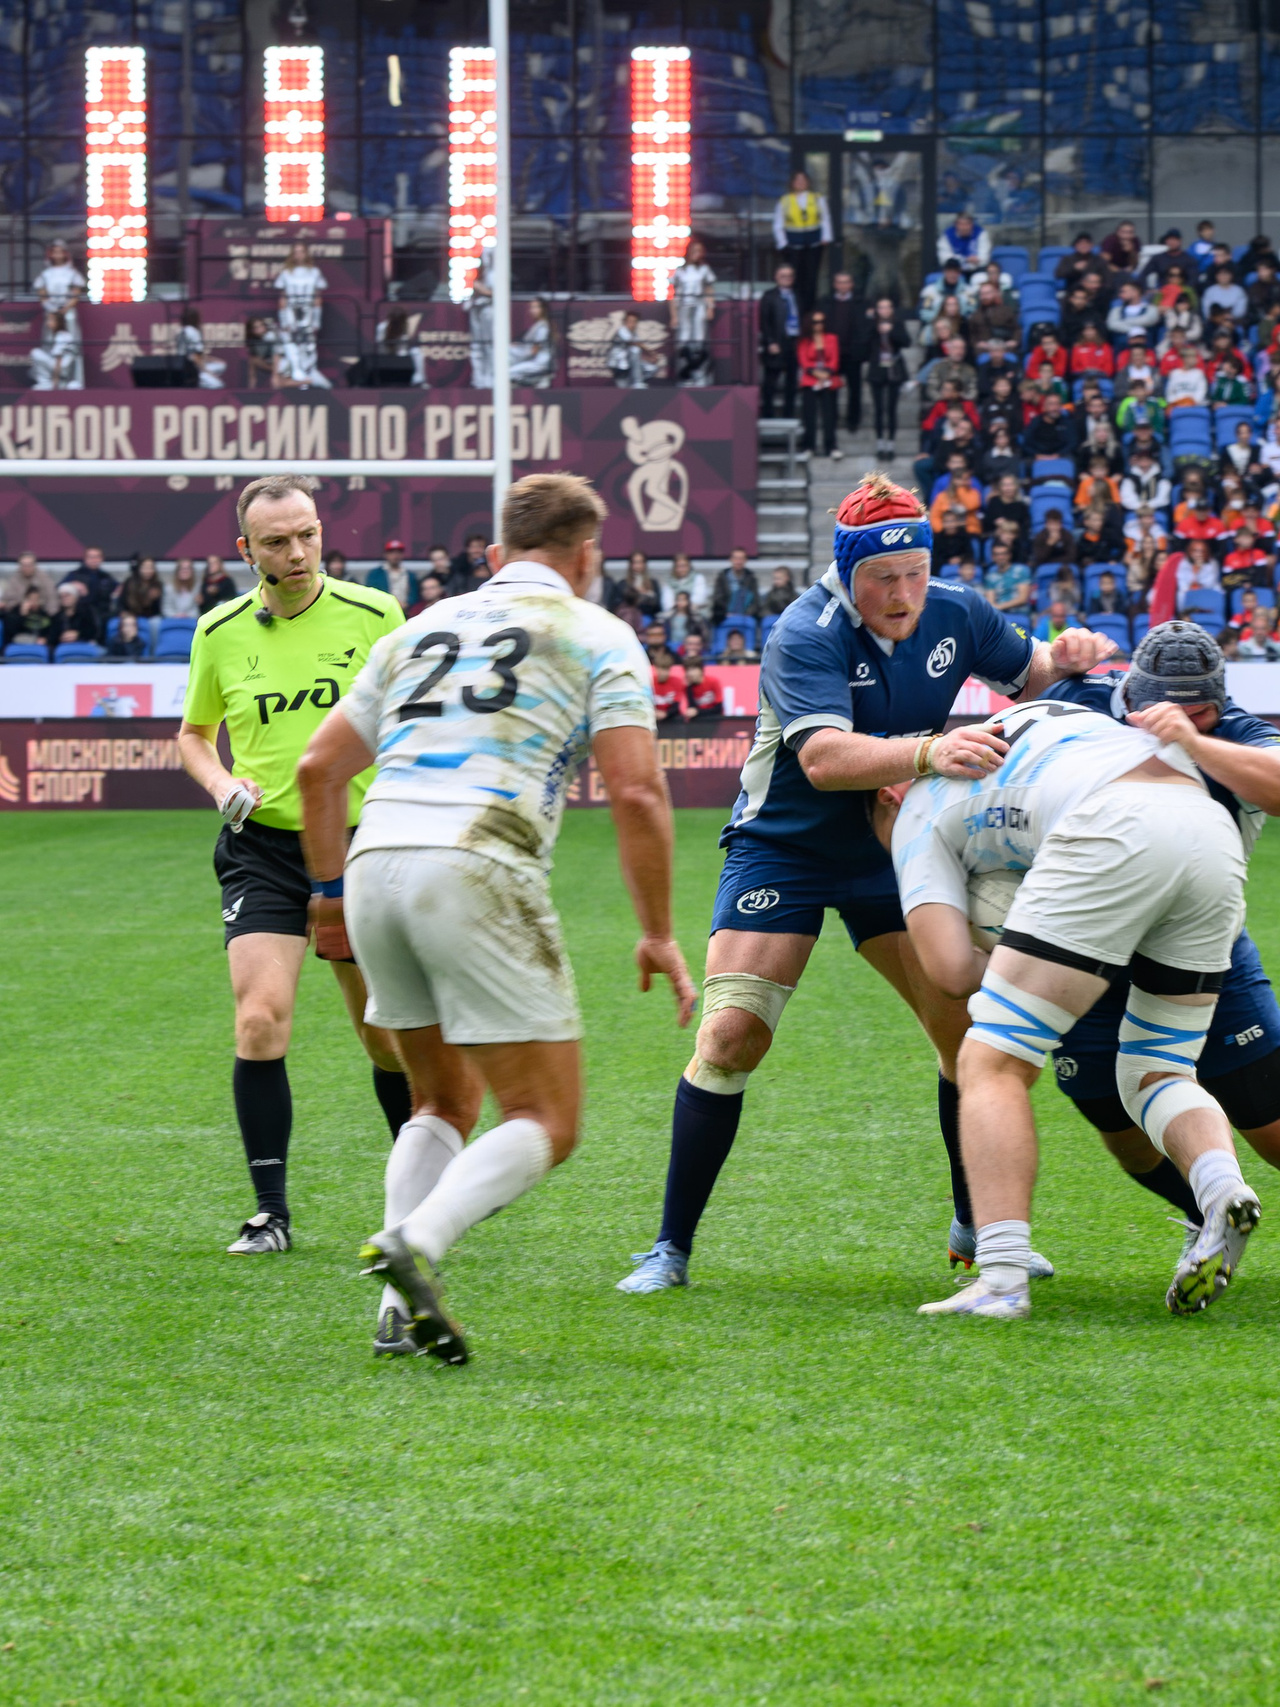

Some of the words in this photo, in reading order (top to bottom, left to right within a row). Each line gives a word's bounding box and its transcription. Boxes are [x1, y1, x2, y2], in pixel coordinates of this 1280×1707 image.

[153, 405, 328, 460] РОССИИ
[350, 404, 407, 460] ПО
[399, 627, 531, 723] 23
[27, 771, 107, 803] СПОРТ
[1234, 1024, 1264, 1046] ВТБ
